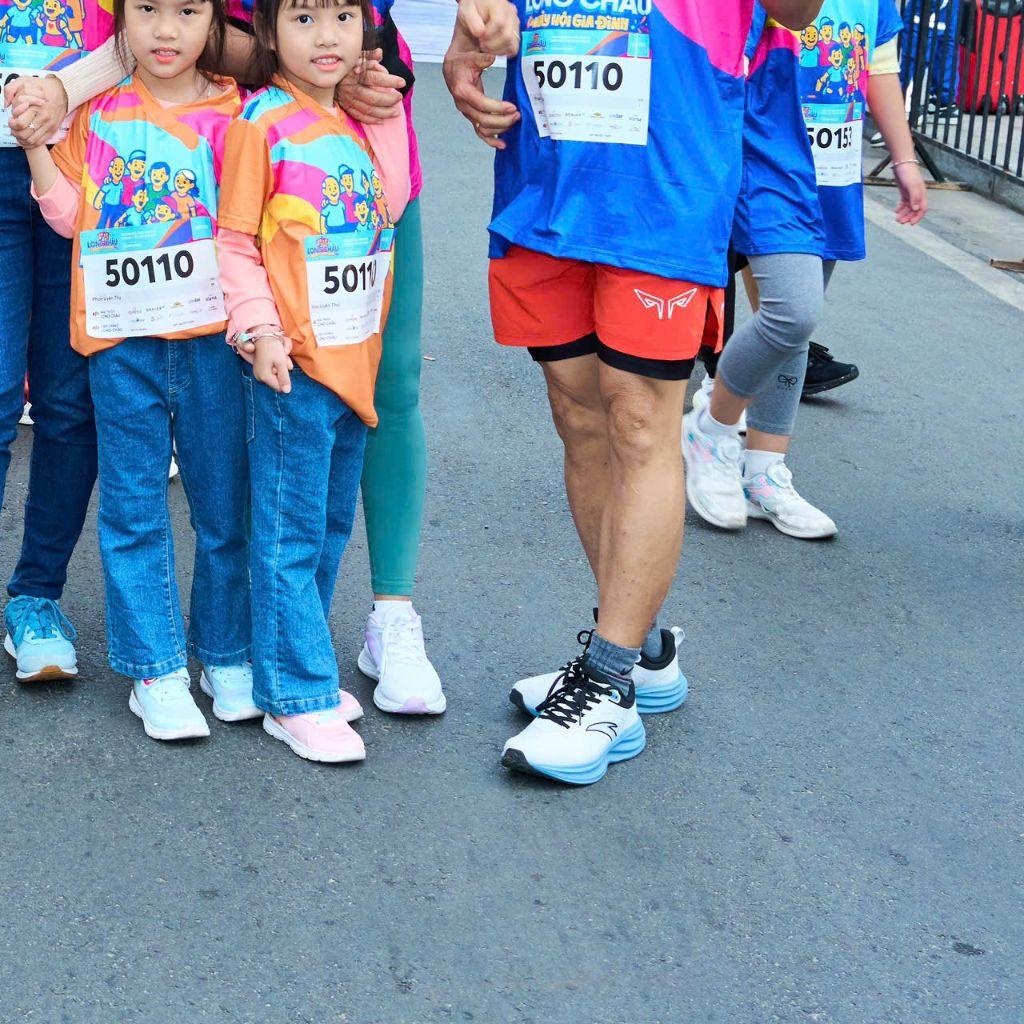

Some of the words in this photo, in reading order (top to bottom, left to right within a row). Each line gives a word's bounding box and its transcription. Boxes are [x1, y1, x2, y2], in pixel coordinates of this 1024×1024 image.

[572, 14, 595, 28] GIA
[533, 60, 624, 91] 50110
[105, 249, 194, 287] 50110
